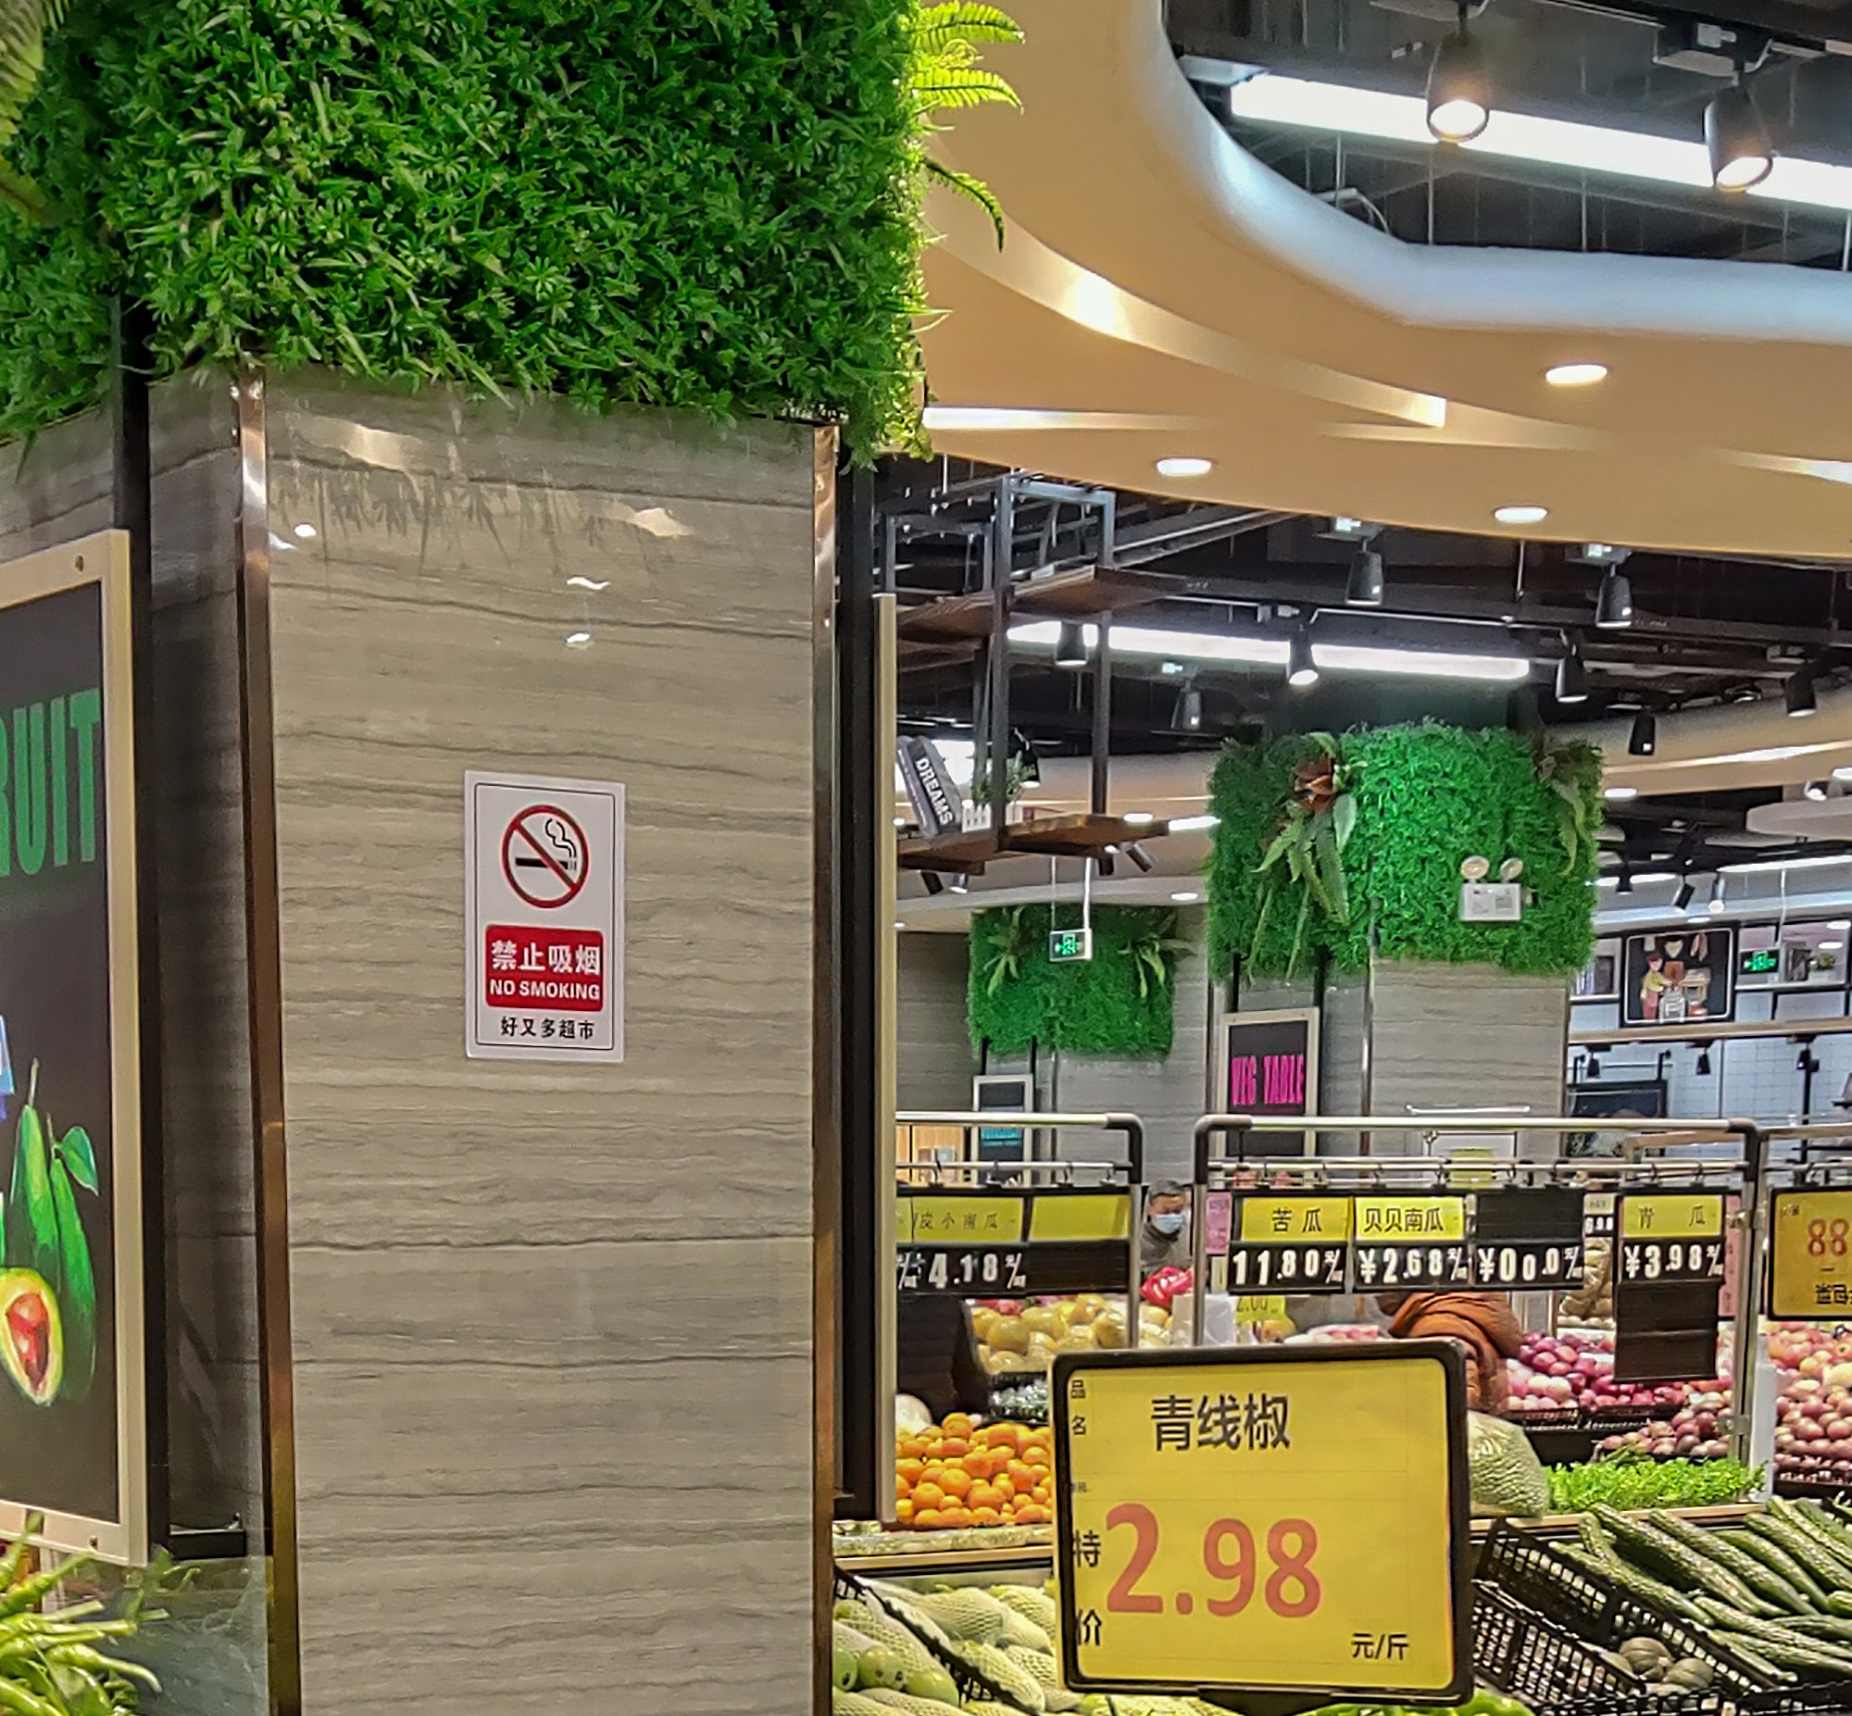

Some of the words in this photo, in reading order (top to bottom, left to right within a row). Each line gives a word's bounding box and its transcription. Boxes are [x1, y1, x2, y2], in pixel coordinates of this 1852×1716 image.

[915, 758, 954, 826] DREAMS
[491, 940, 601, 975] 禁止吸烟
[489, 979, 516, 995] NO
[519, 981, 600, 1000] SMOKING
[501, 1016, 595, 1040] 好又多超市
[1272, 1207, 1322, 1232] 苦瓜
[1363, 1208, 1443, 1232] 贝贝南瓜
[1359, 1248, 1443, 1284] ¥2.68
[1624, 1244, 1702, 1279] ¥3.98
[1151, 1393, 1291, 1451] 青线椒
[1105, 1502, 1323, 1618] 2.98
[1351, 1633, 1410, 1661] 元/斤
